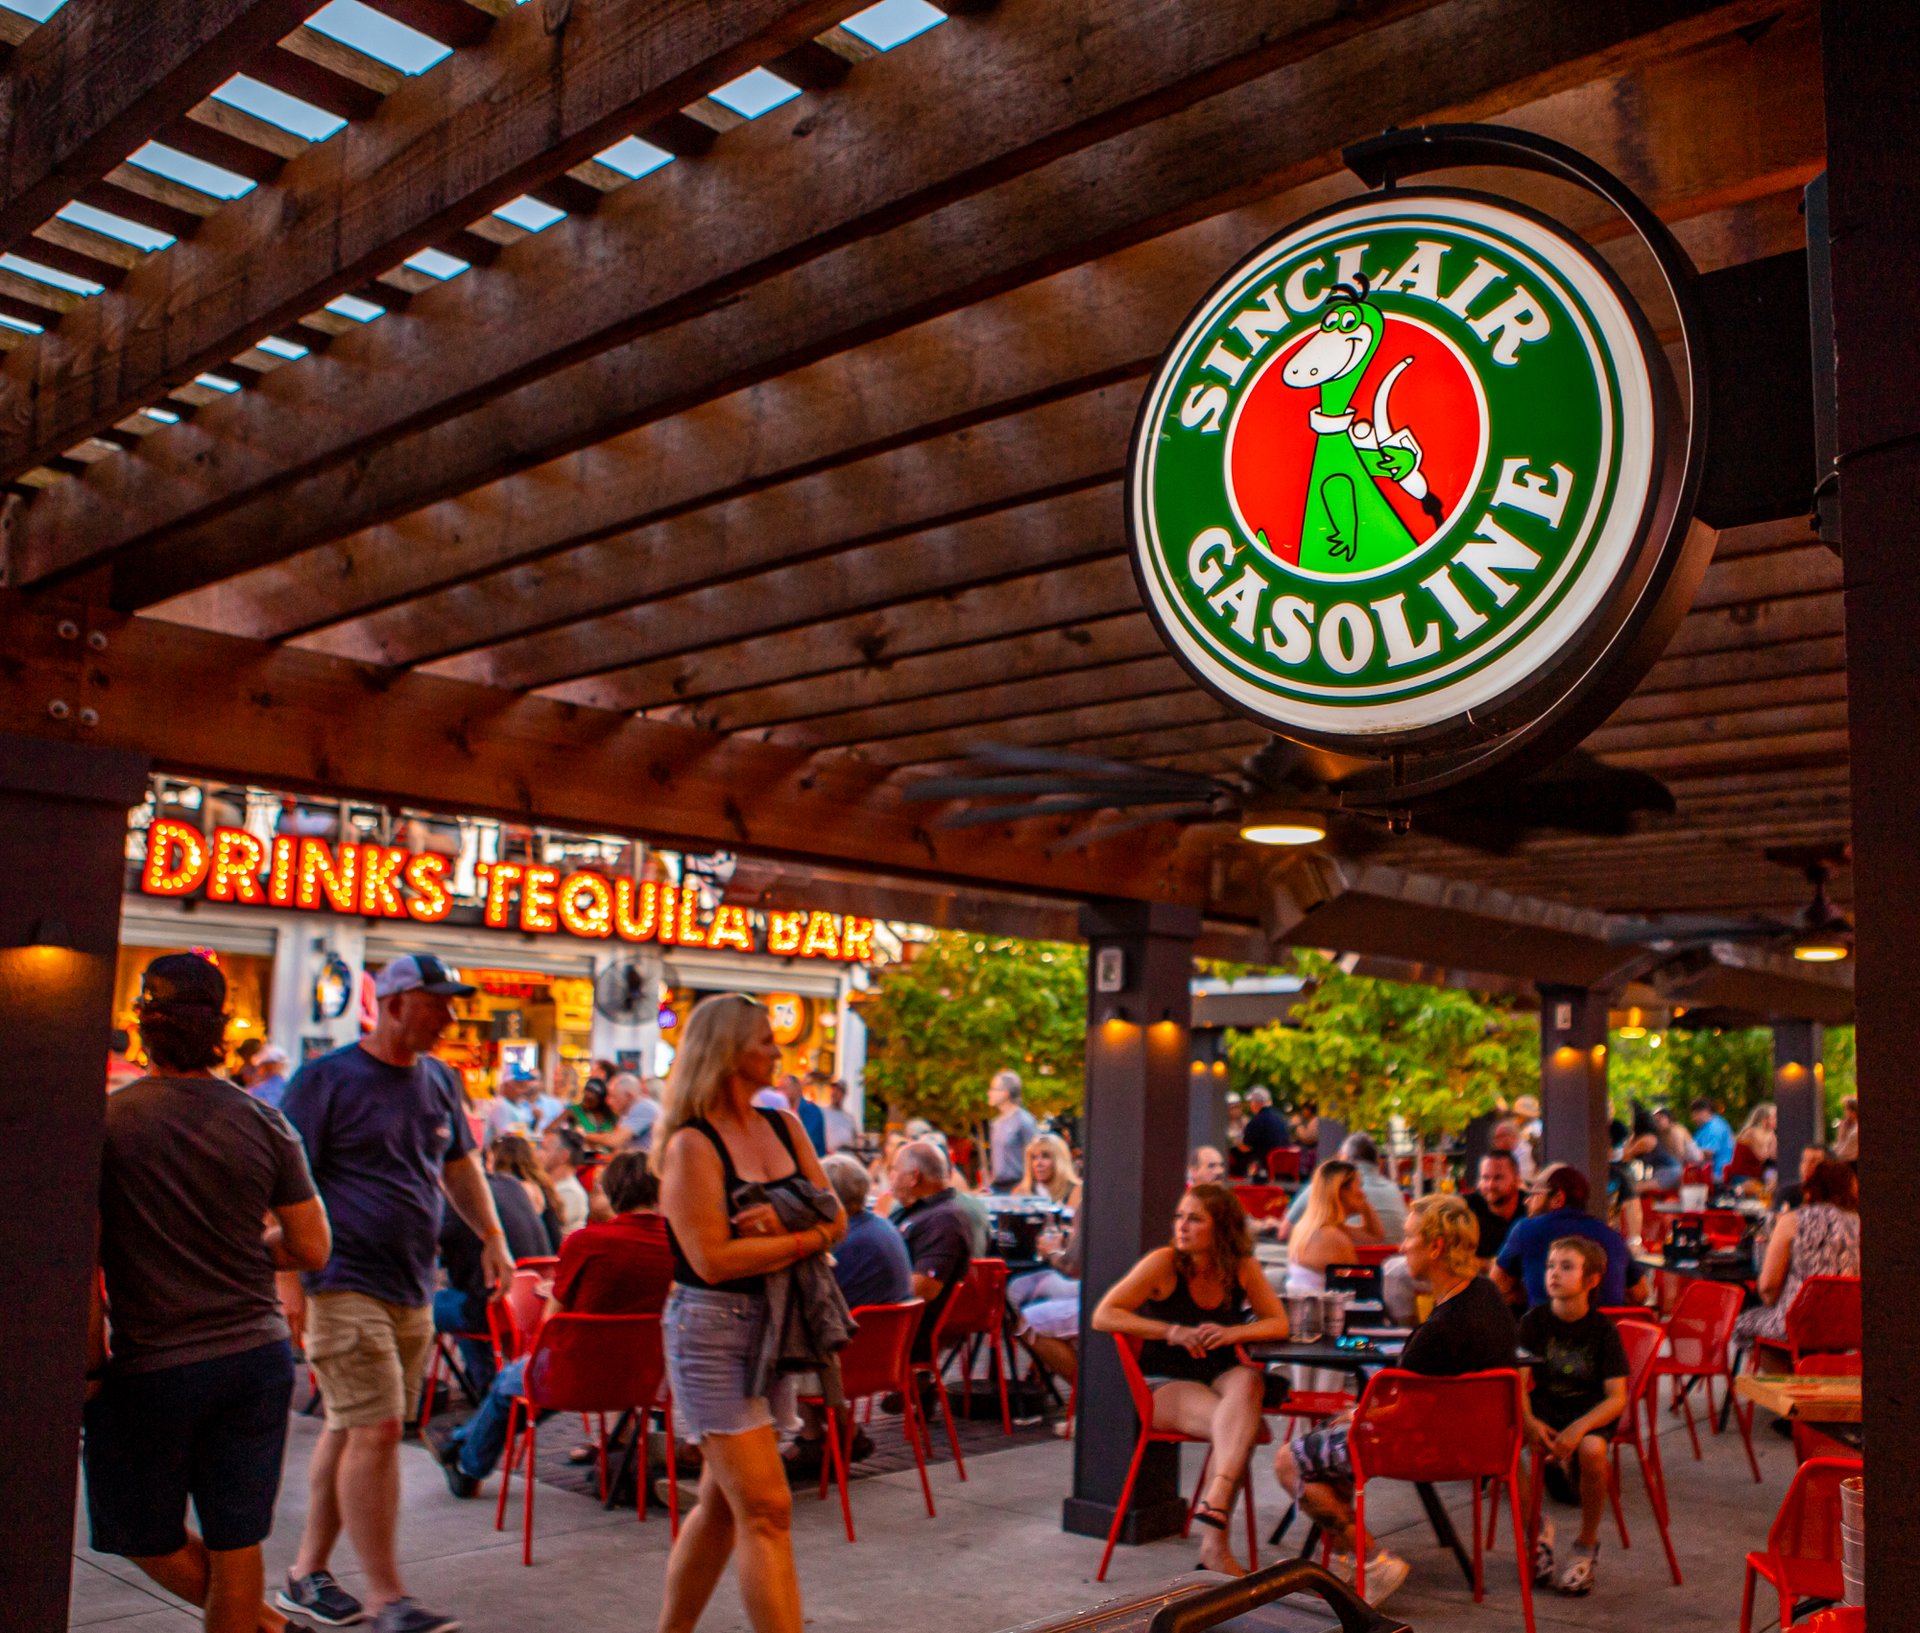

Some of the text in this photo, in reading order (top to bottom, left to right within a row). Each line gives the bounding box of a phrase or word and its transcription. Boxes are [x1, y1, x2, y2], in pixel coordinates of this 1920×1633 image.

[1181, 240, 1552, 433] SINCLAIR
[1188, 457, 1573, 674] GASOLINE
[142, 819, 873, 961] DRINKS TEQUILA BAR
